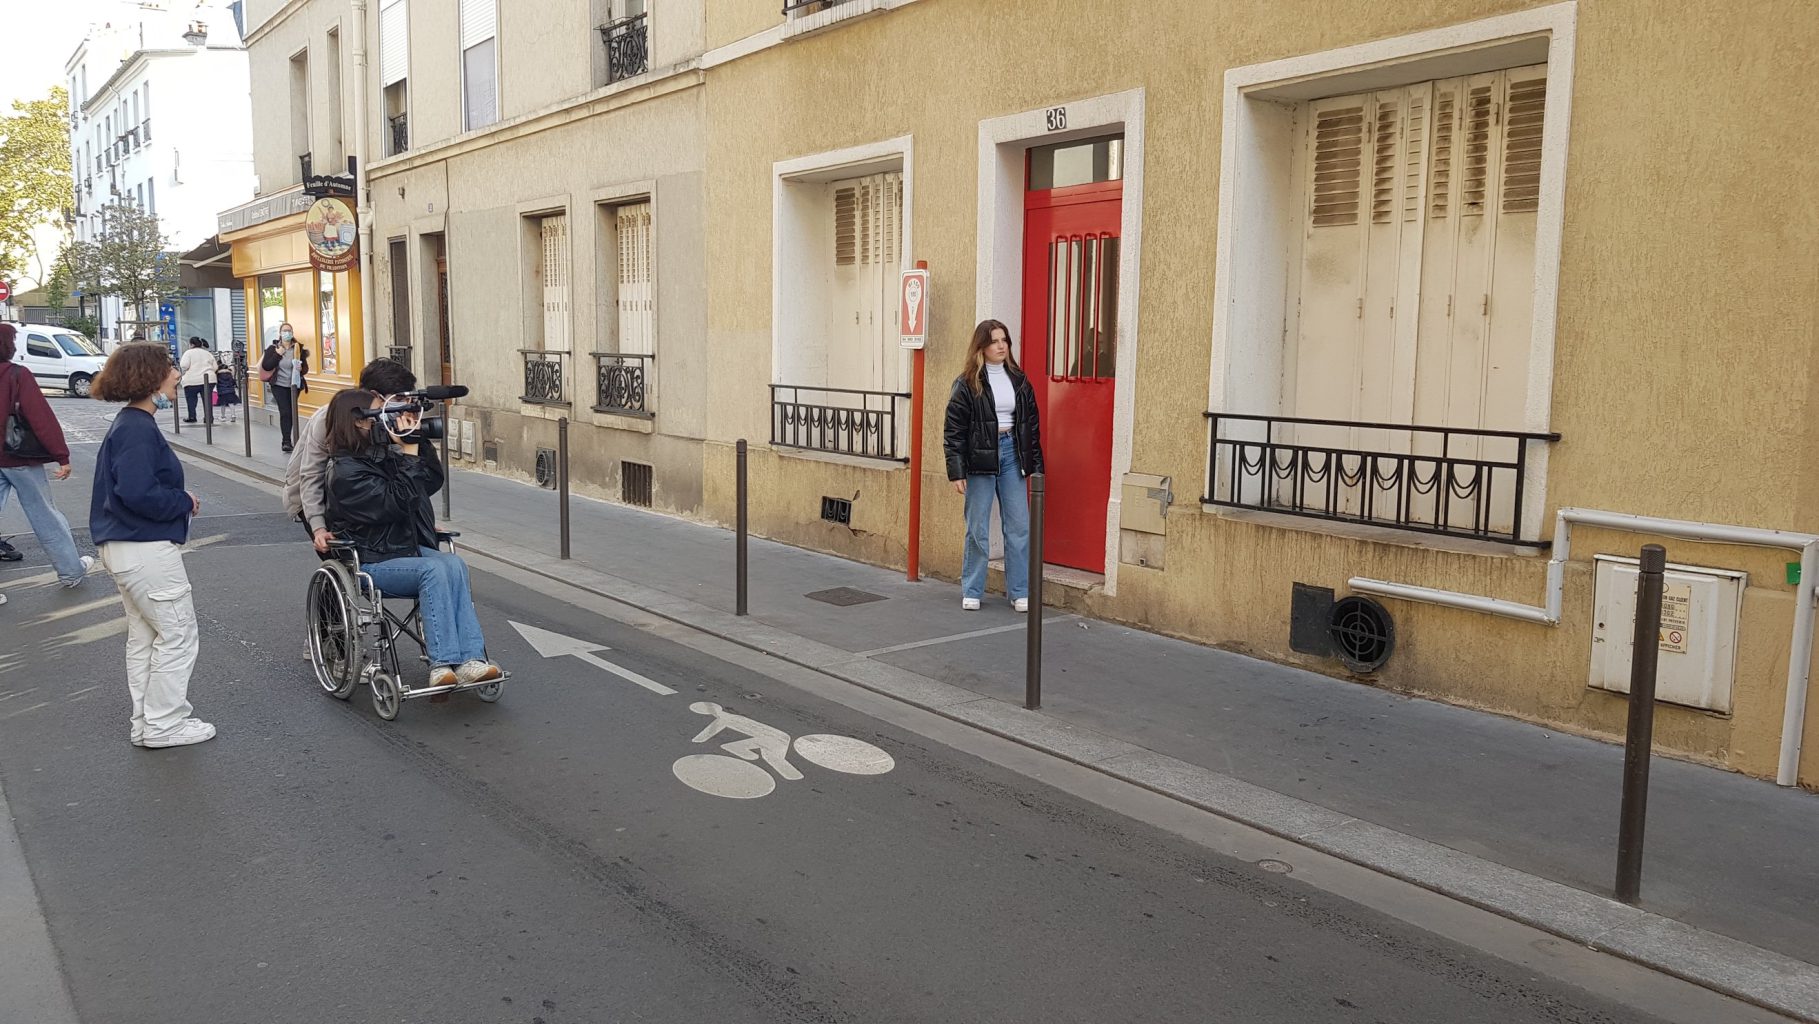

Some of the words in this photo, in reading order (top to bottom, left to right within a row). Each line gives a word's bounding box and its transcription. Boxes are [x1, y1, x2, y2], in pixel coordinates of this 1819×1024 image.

[1047, 109, 1066, 130] 36
[306, 181, 323, 189] Feuille
[324, 181, 351, 191] d'Automne
